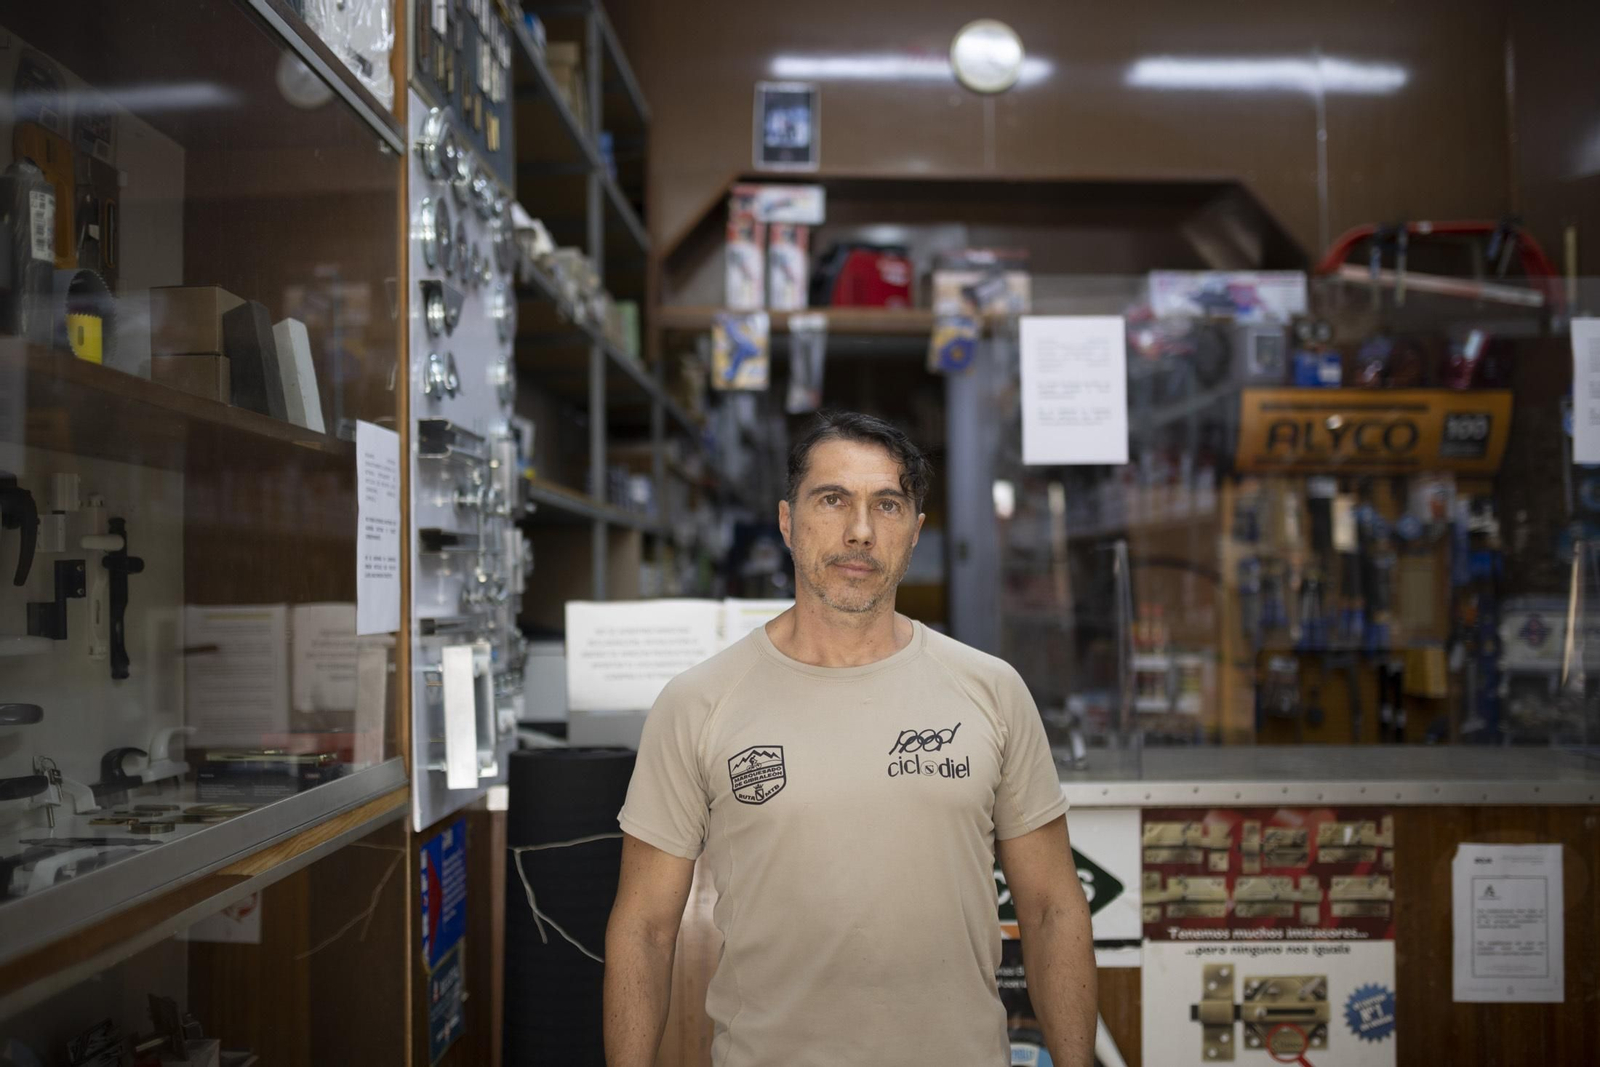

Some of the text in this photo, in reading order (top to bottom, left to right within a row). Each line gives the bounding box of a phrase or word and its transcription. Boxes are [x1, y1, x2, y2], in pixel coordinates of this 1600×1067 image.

[1267, 417, 1419, 454] ALYCO
[734, 766, 782, 783] MARQUESADO
[738, 784, 780, 801] RUTA MTB
[1167, 926, 1231, 940] Tenemos
[1232, 927, 1284, 940] muchos
[1230, 944, 1283, 958] ninguno
[1285, 945, 1309, 956] nos
